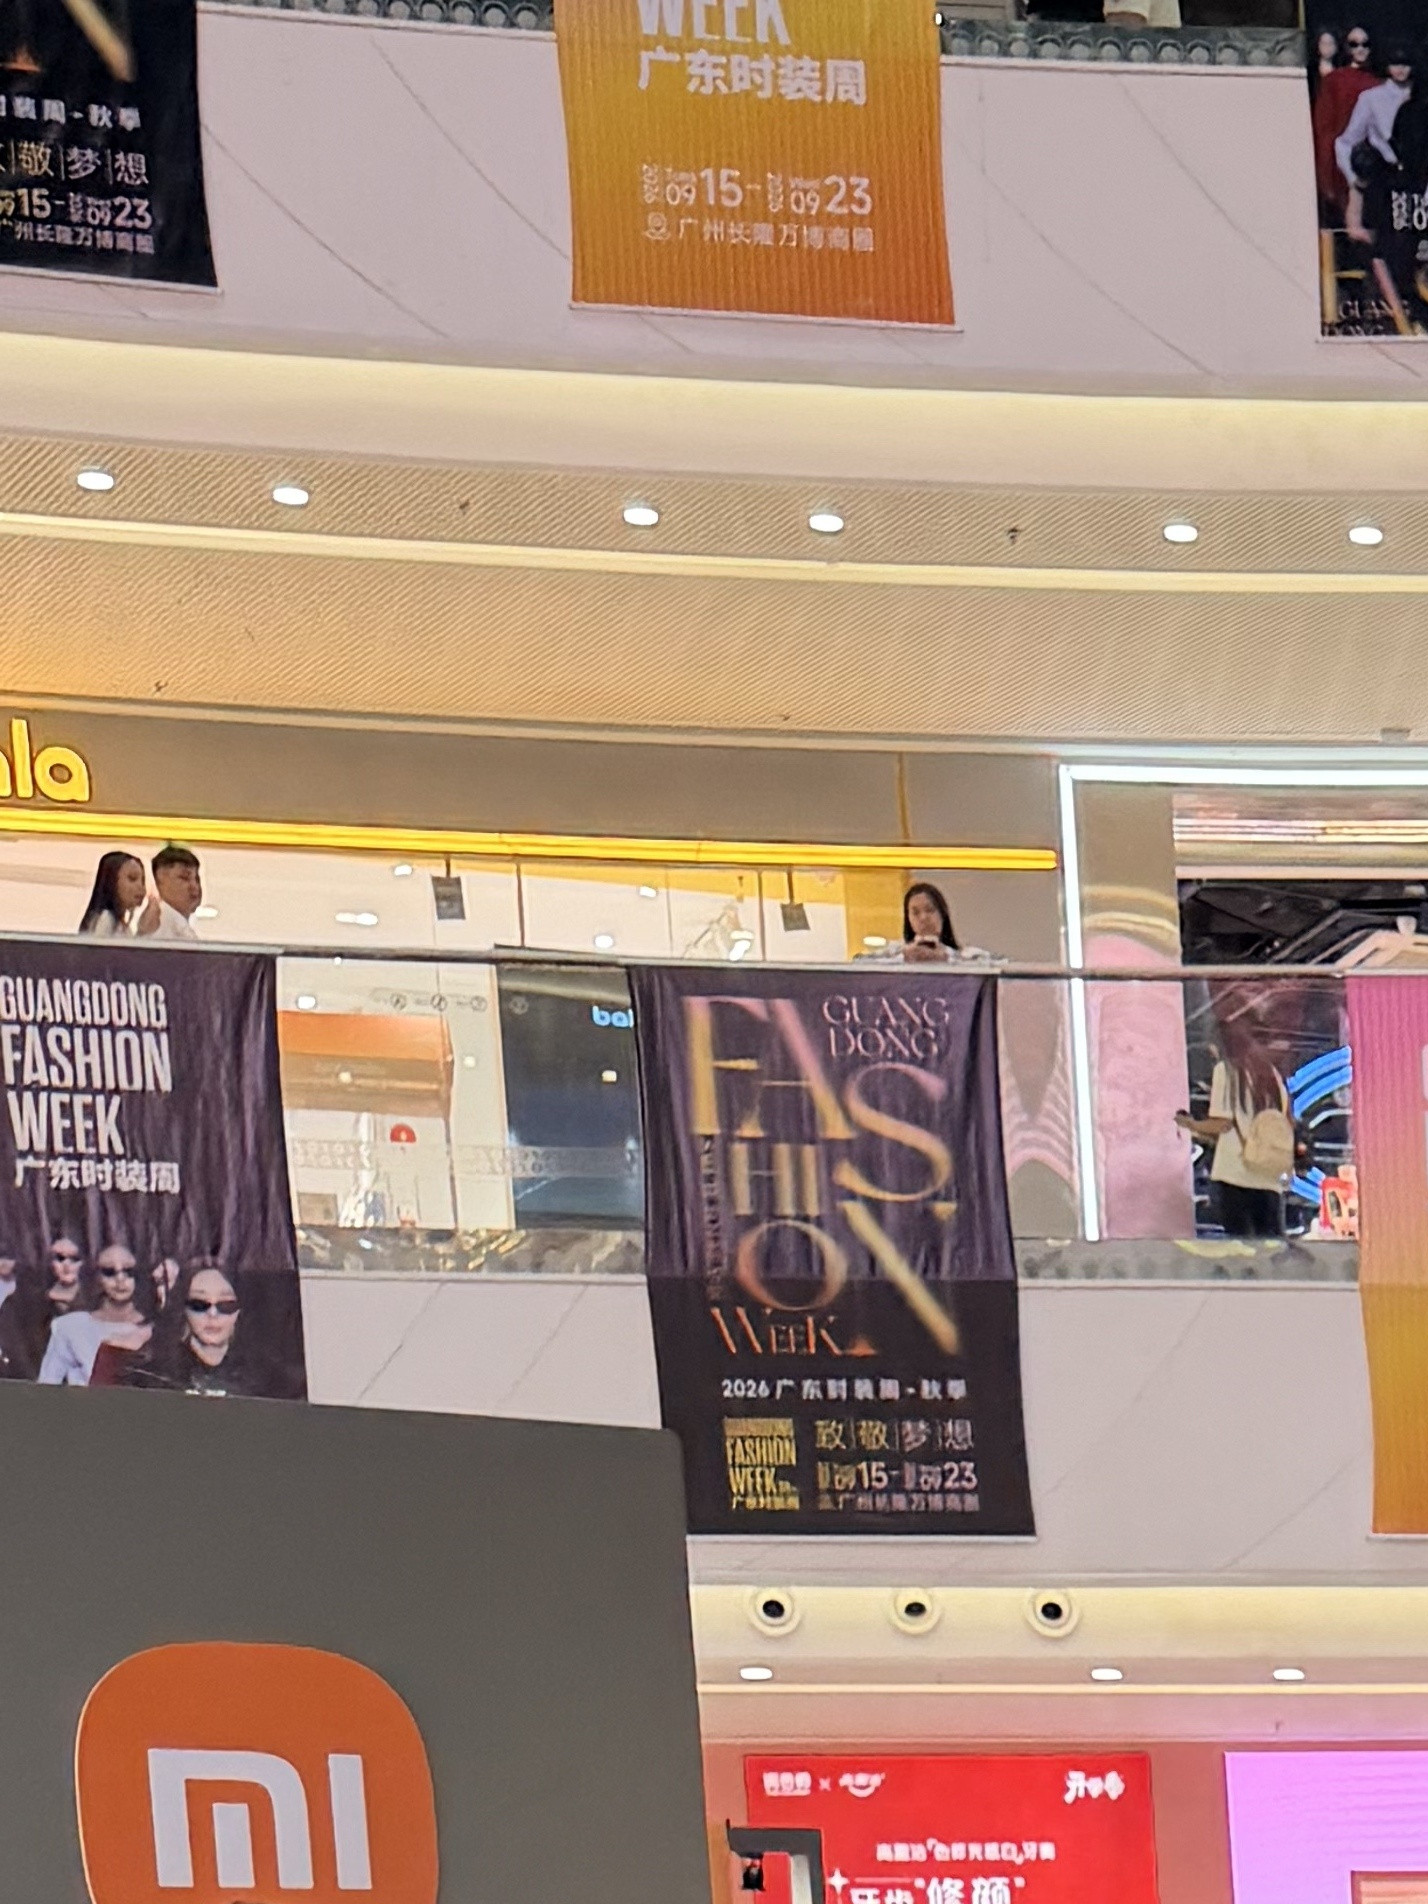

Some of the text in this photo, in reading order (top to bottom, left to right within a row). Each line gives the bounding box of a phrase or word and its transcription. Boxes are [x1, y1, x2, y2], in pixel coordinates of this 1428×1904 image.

[639, 46, 867, 106] 广东时装周
[112, 196, 152, 230] 23
[700, 167, 743, 207] 15
[824, 174, 873, 215] 23
[0, 975, 168, 1030] GUANGDONG
[0, 1023, 173, 1093] FASHION
[7, 1090, 126, 1156] WEEK
[14, 1157, 181, 1195] 广东时装周
[943, 1461, 979, 1491] 23
